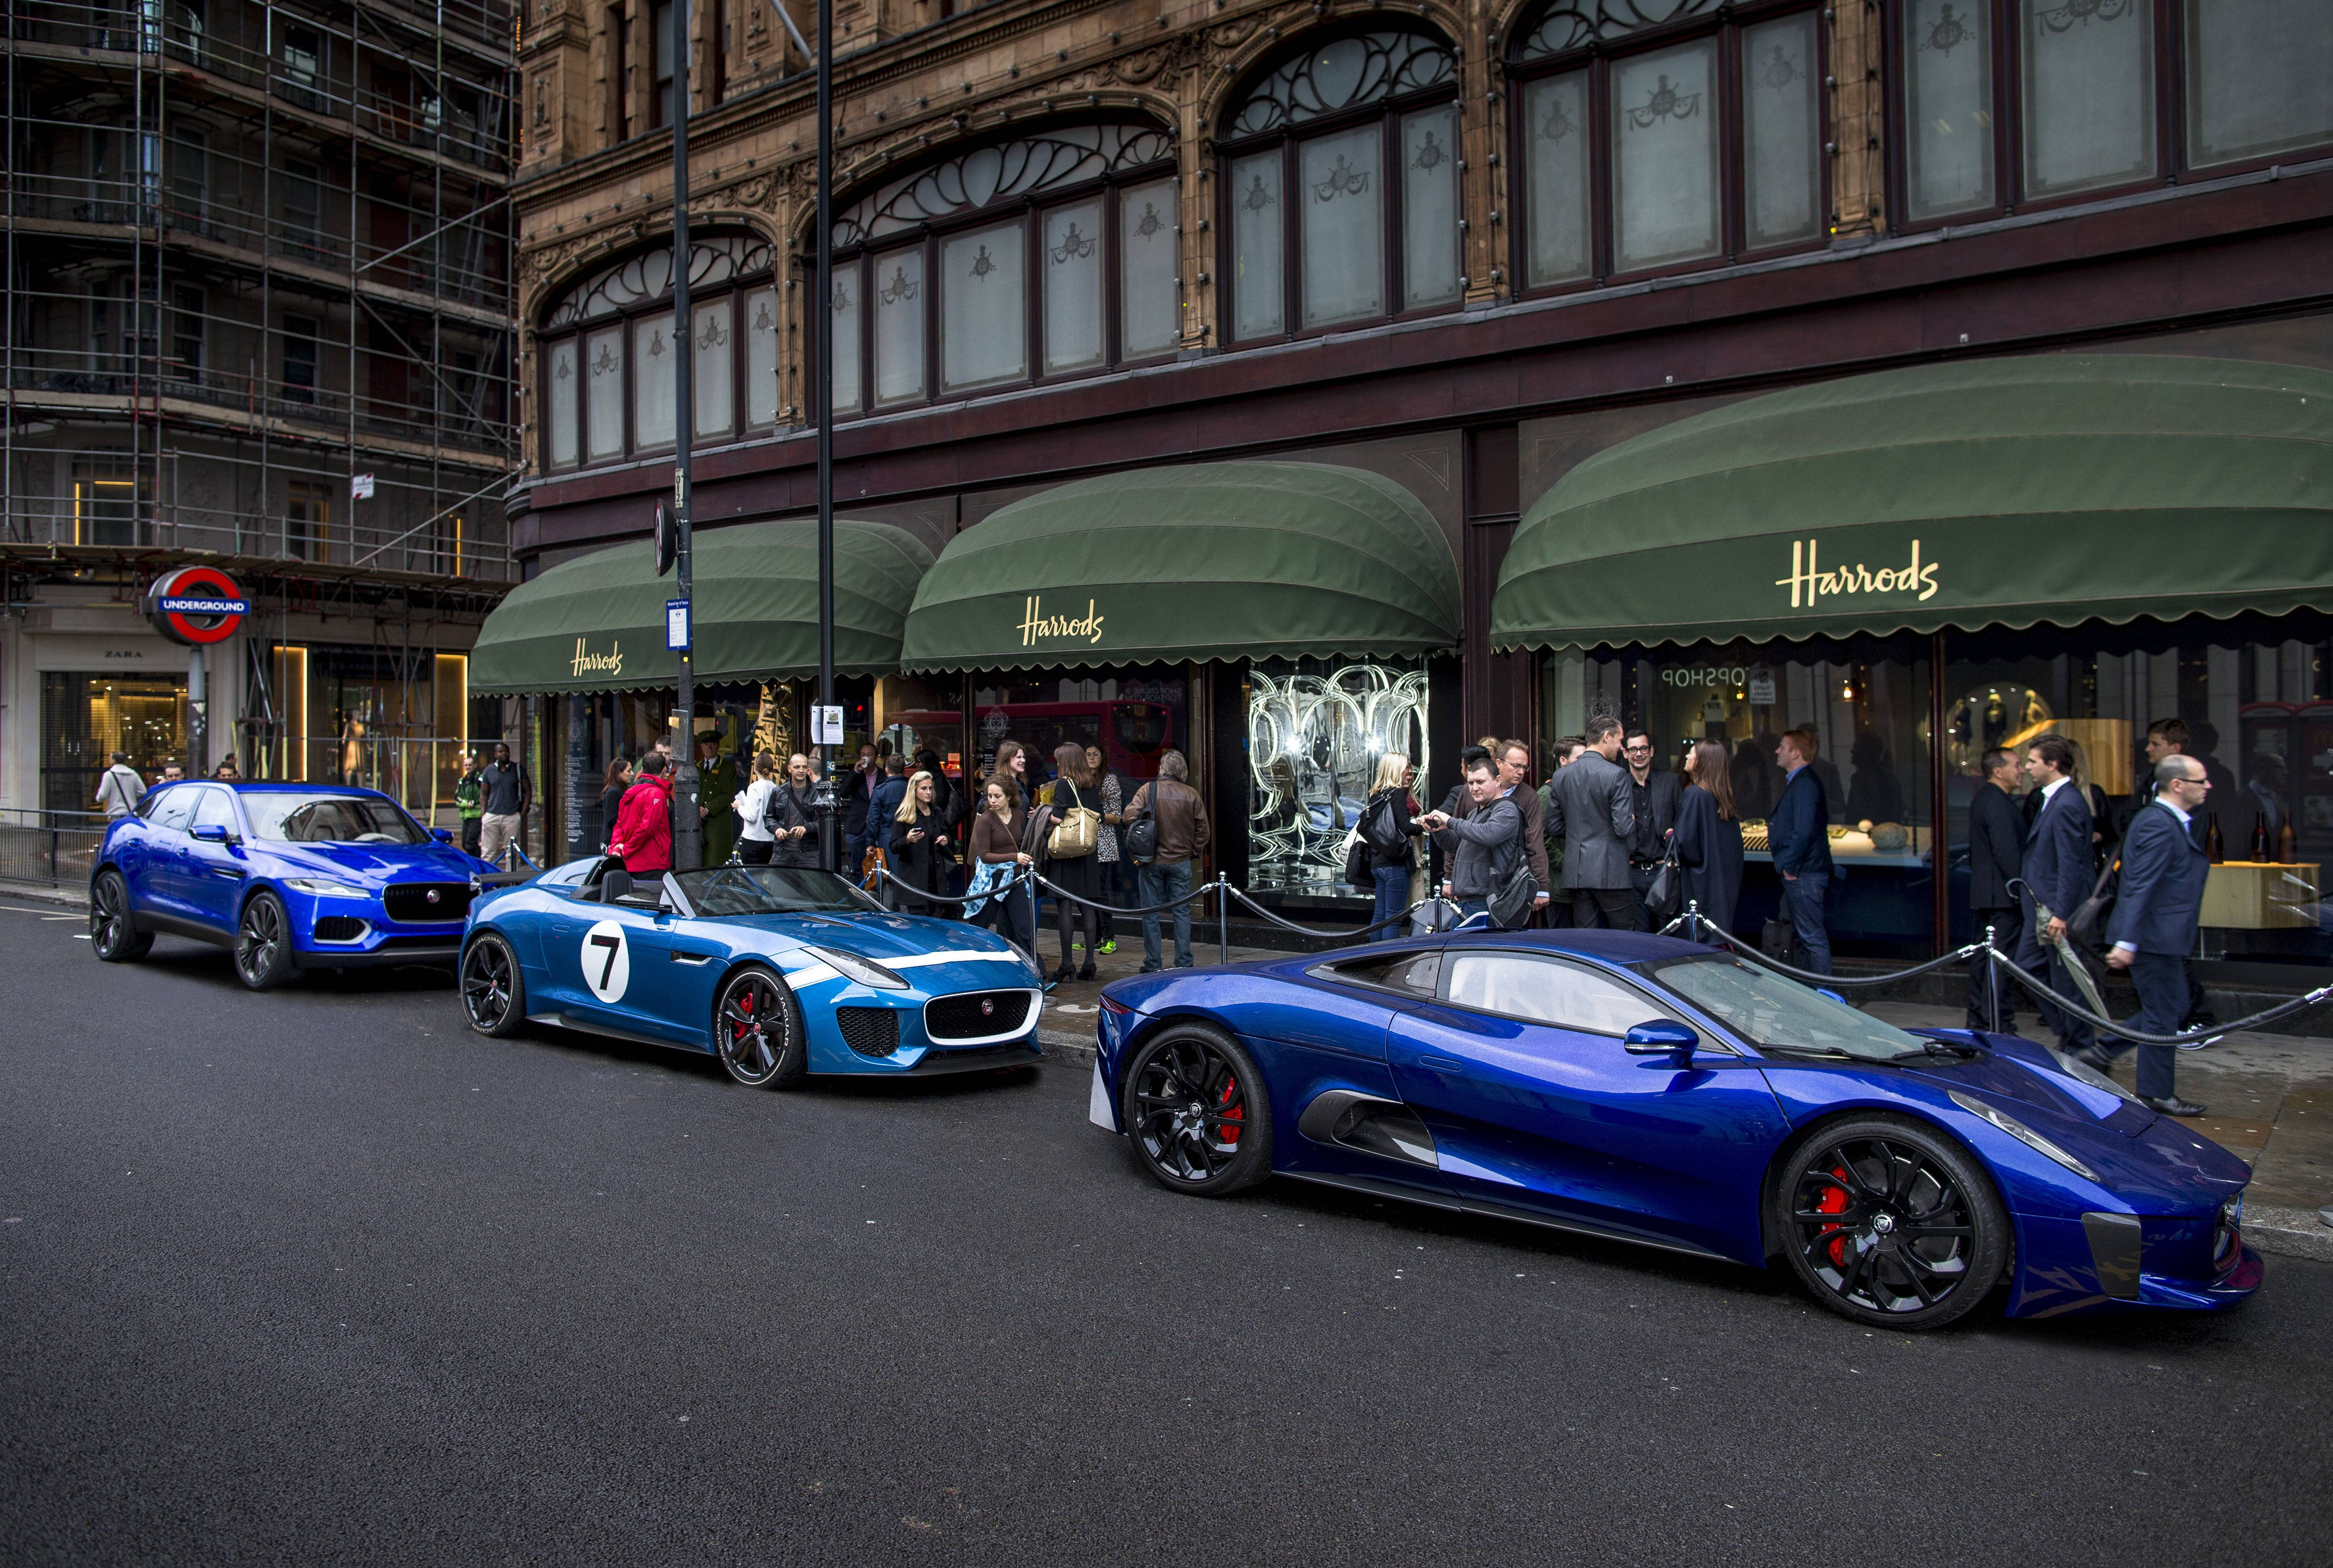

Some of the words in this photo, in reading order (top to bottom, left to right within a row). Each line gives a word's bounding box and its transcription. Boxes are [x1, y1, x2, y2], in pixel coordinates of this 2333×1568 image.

[1775, 539, 1939, 608] Harrods
[163, 600, 244, 611] UNDERGROUND
[1016, 595, 1104, 646] Harrods
[570, 638, 623, 677] Harrods
[477, 936, 501, 945] JAGUAR
[591, 934, 620, 990] 7
[717, 1013, 728, 1063] JAGUAR
[778, 994, 789, 1046] JAGUAR
